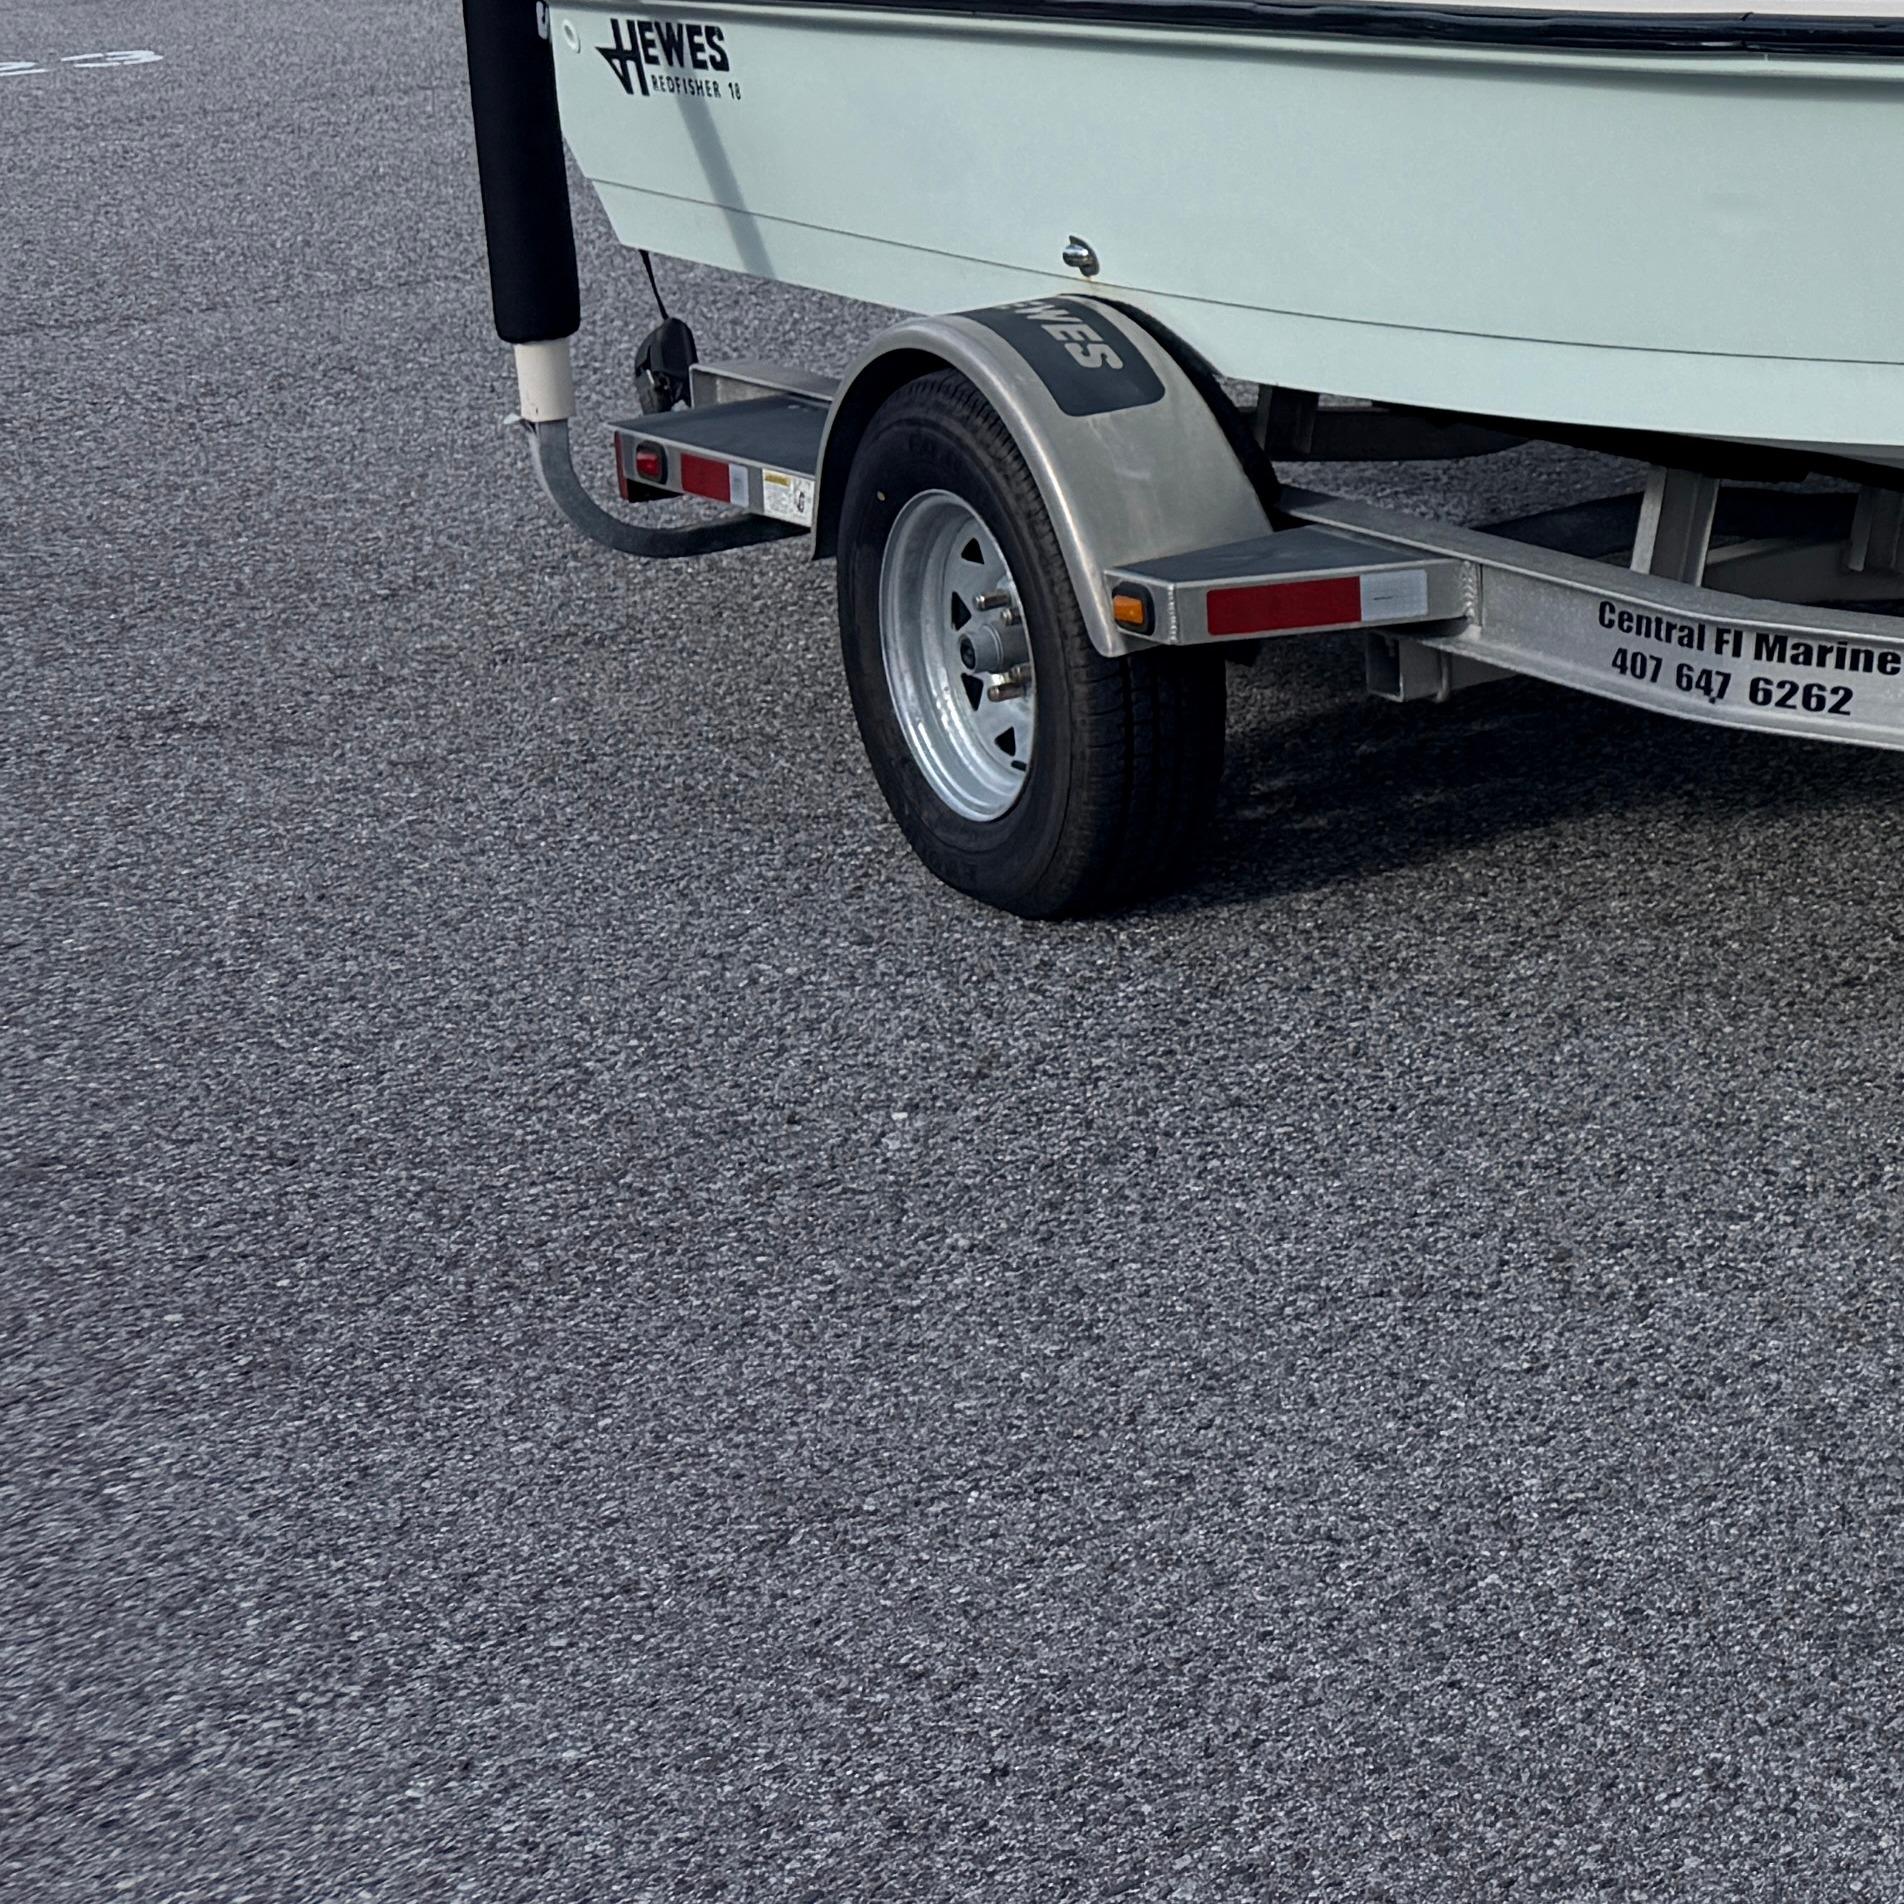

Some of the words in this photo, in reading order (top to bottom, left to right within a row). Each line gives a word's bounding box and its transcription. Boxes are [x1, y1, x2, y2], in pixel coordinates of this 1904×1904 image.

[594, 18, 730, 96] HEWES
[651, 74, 722, 98] REDFISHER
[728, 82, 742, 100] 18
[1599, 600, 1705, 651] Central
[1754, 635, 1902, 676] Marine
[1611, 648, 1663, 683] 407
[1676, 662, 1732, 700] 647
[1749, 678, 1853, 716] 6262
